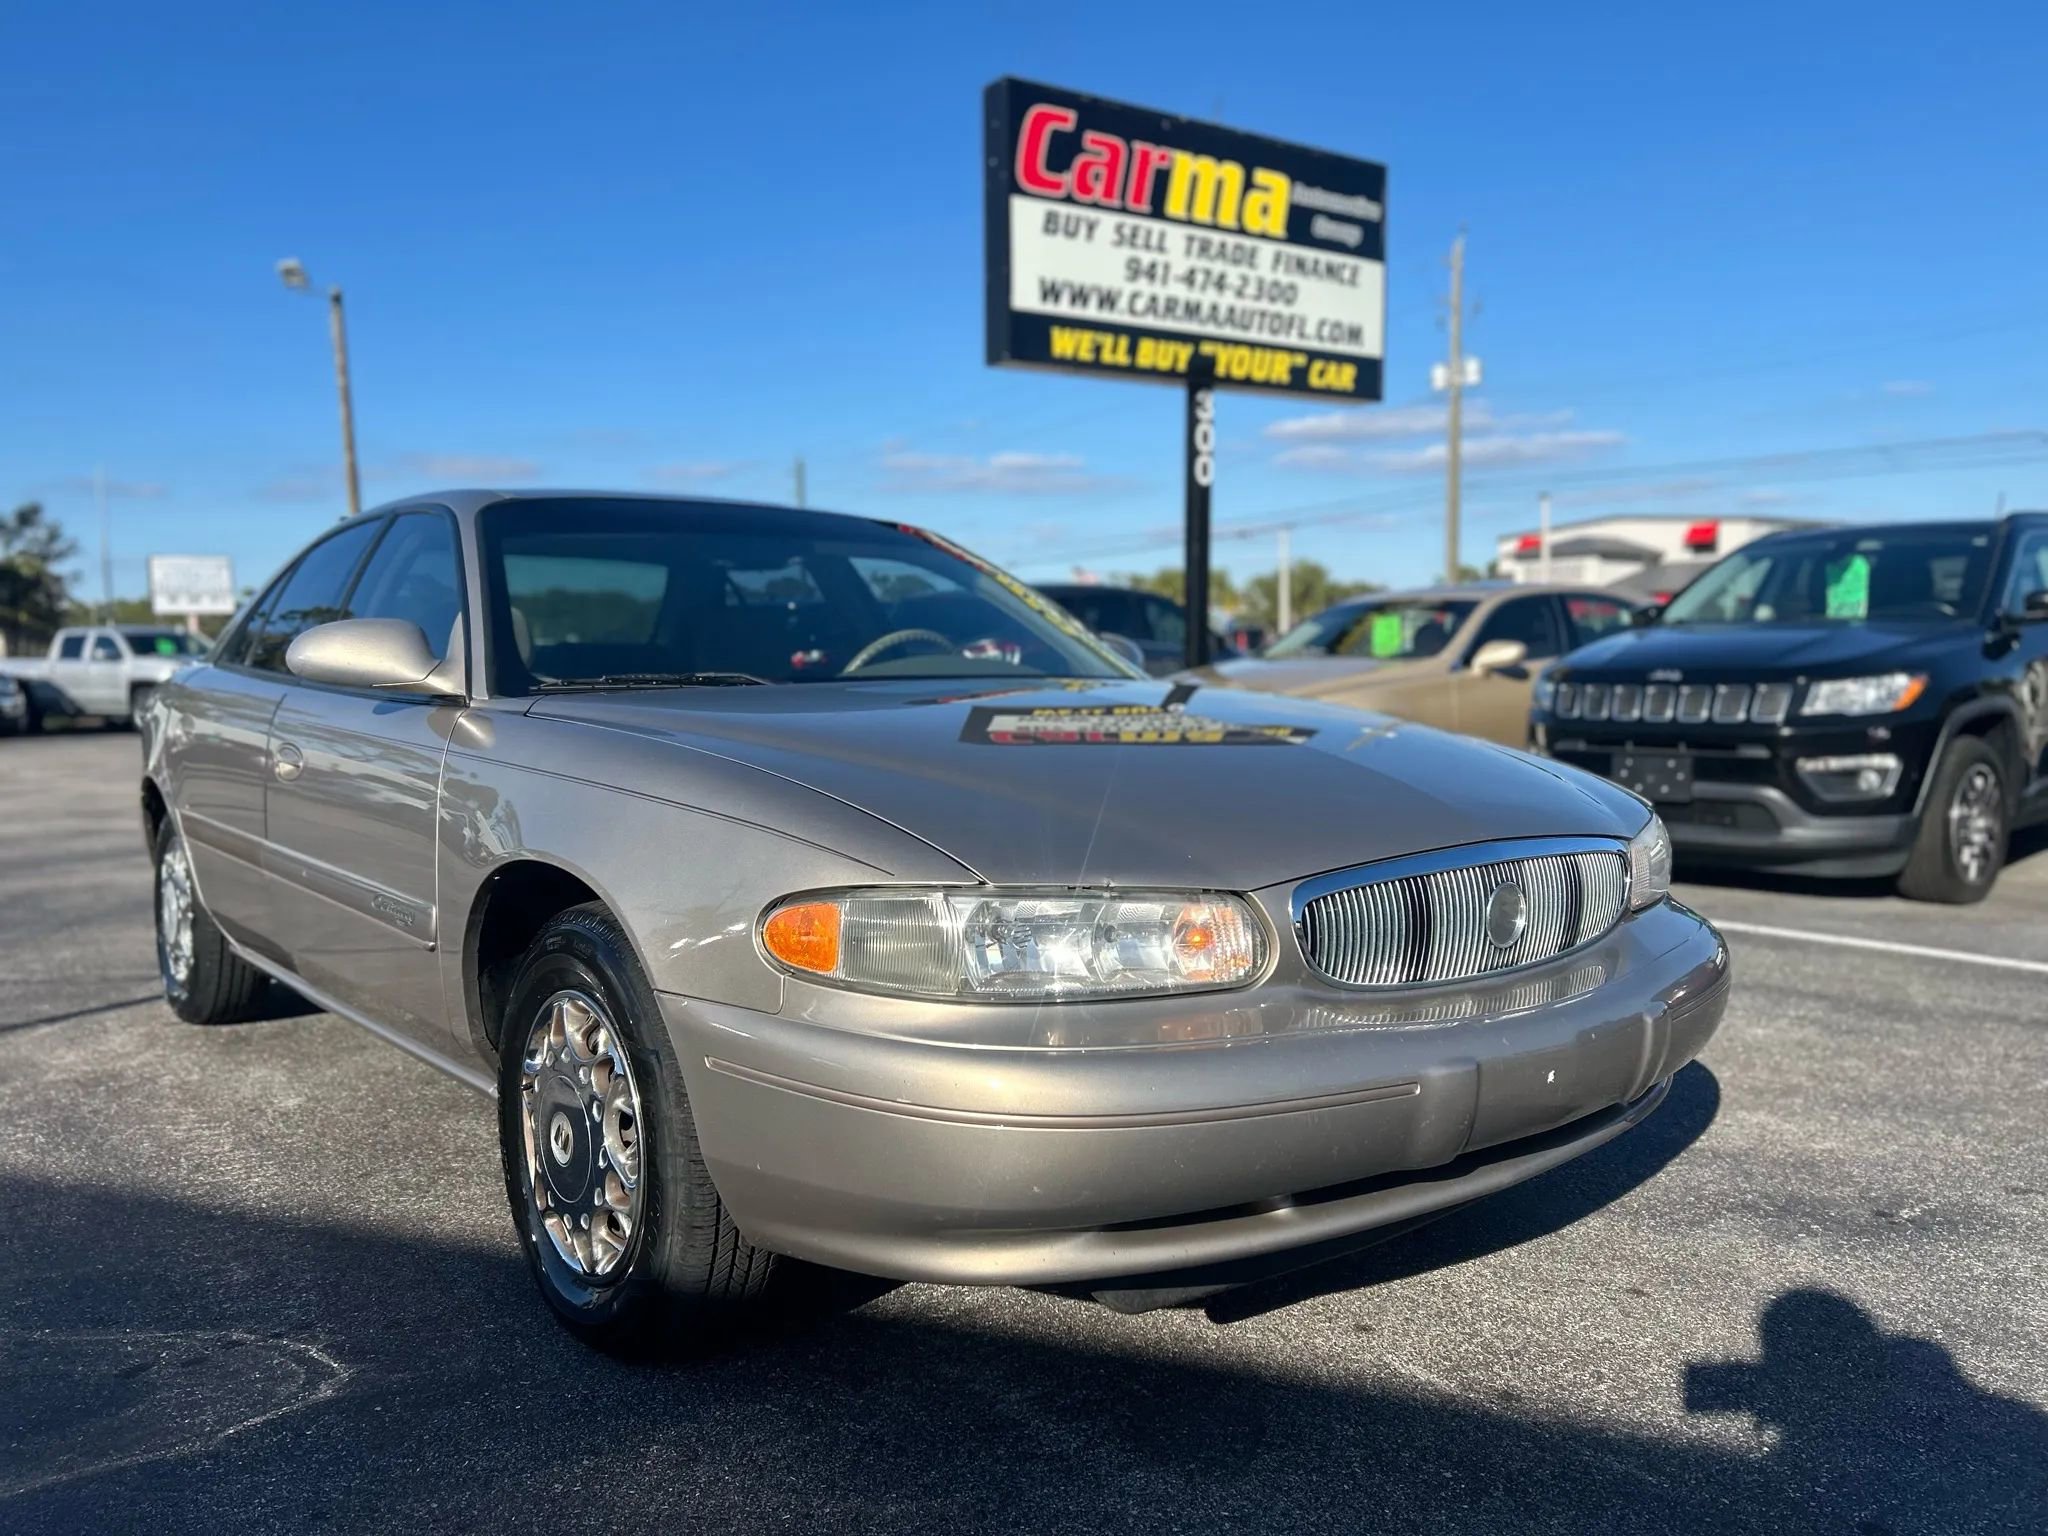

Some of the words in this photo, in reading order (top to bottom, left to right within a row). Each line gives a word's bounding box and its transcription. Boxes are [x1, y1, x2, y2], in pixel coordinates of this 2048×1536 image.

[1016, 104, 1291, 239] Carma
[1042, 209, 1100, 243] BUY
[1111, 222, 1168, 254] SELL
[1184, 234, 1258, 270] TRADE
[1270, 249, 1360, 287] FINANCE
[1125, 257, 1298, 305] 941-474-2300
[1038, 276, 1364, 346] WWW.CARMAAUTOFL.COM
[1050, 326, 1130, 366] WE'LL
[1135, 338, 1194, 373] BUY
[1199, 341, 1307, 385] "YOUR"
[1308, 359, 1357, 392] CAR
